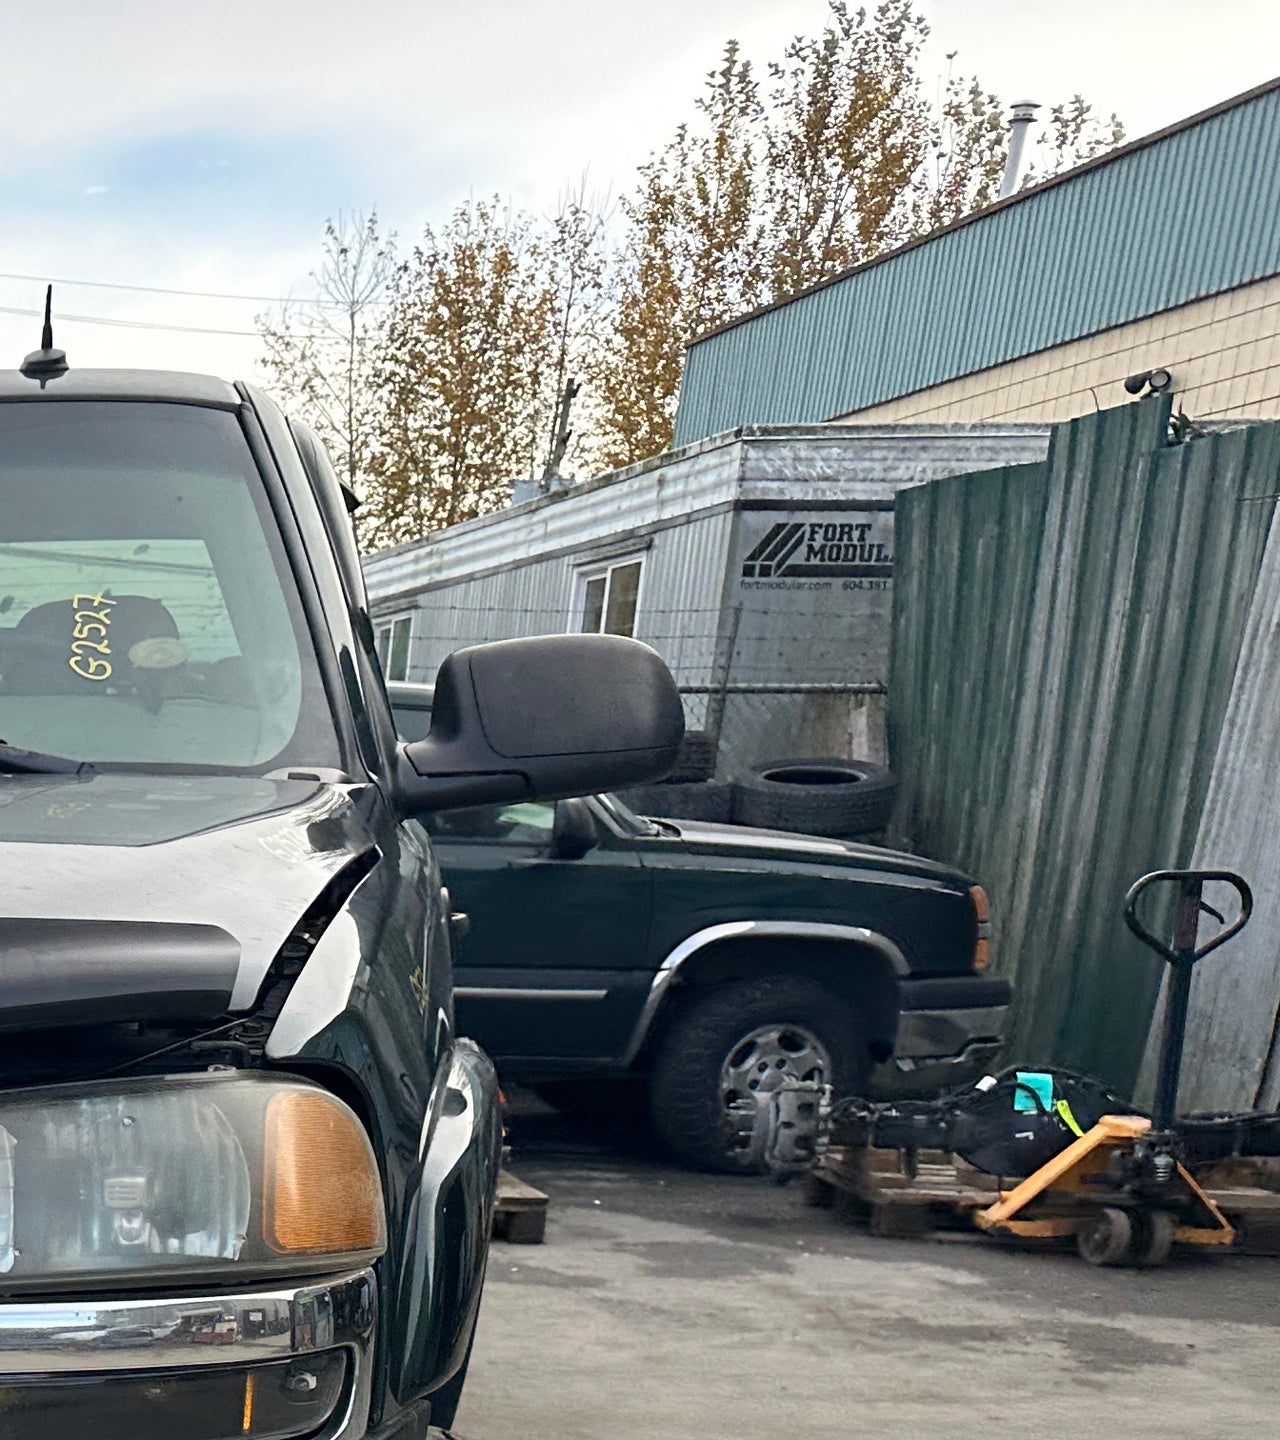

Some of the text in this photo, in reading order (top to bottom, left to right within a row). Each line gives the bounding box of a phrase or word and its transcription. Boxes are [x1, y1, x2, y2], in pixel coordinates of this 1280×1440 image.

[806, 523, 873, 542] FORT
[804, 543, 895, 563] MODUL
[69, 592, 117, 681] G2527
